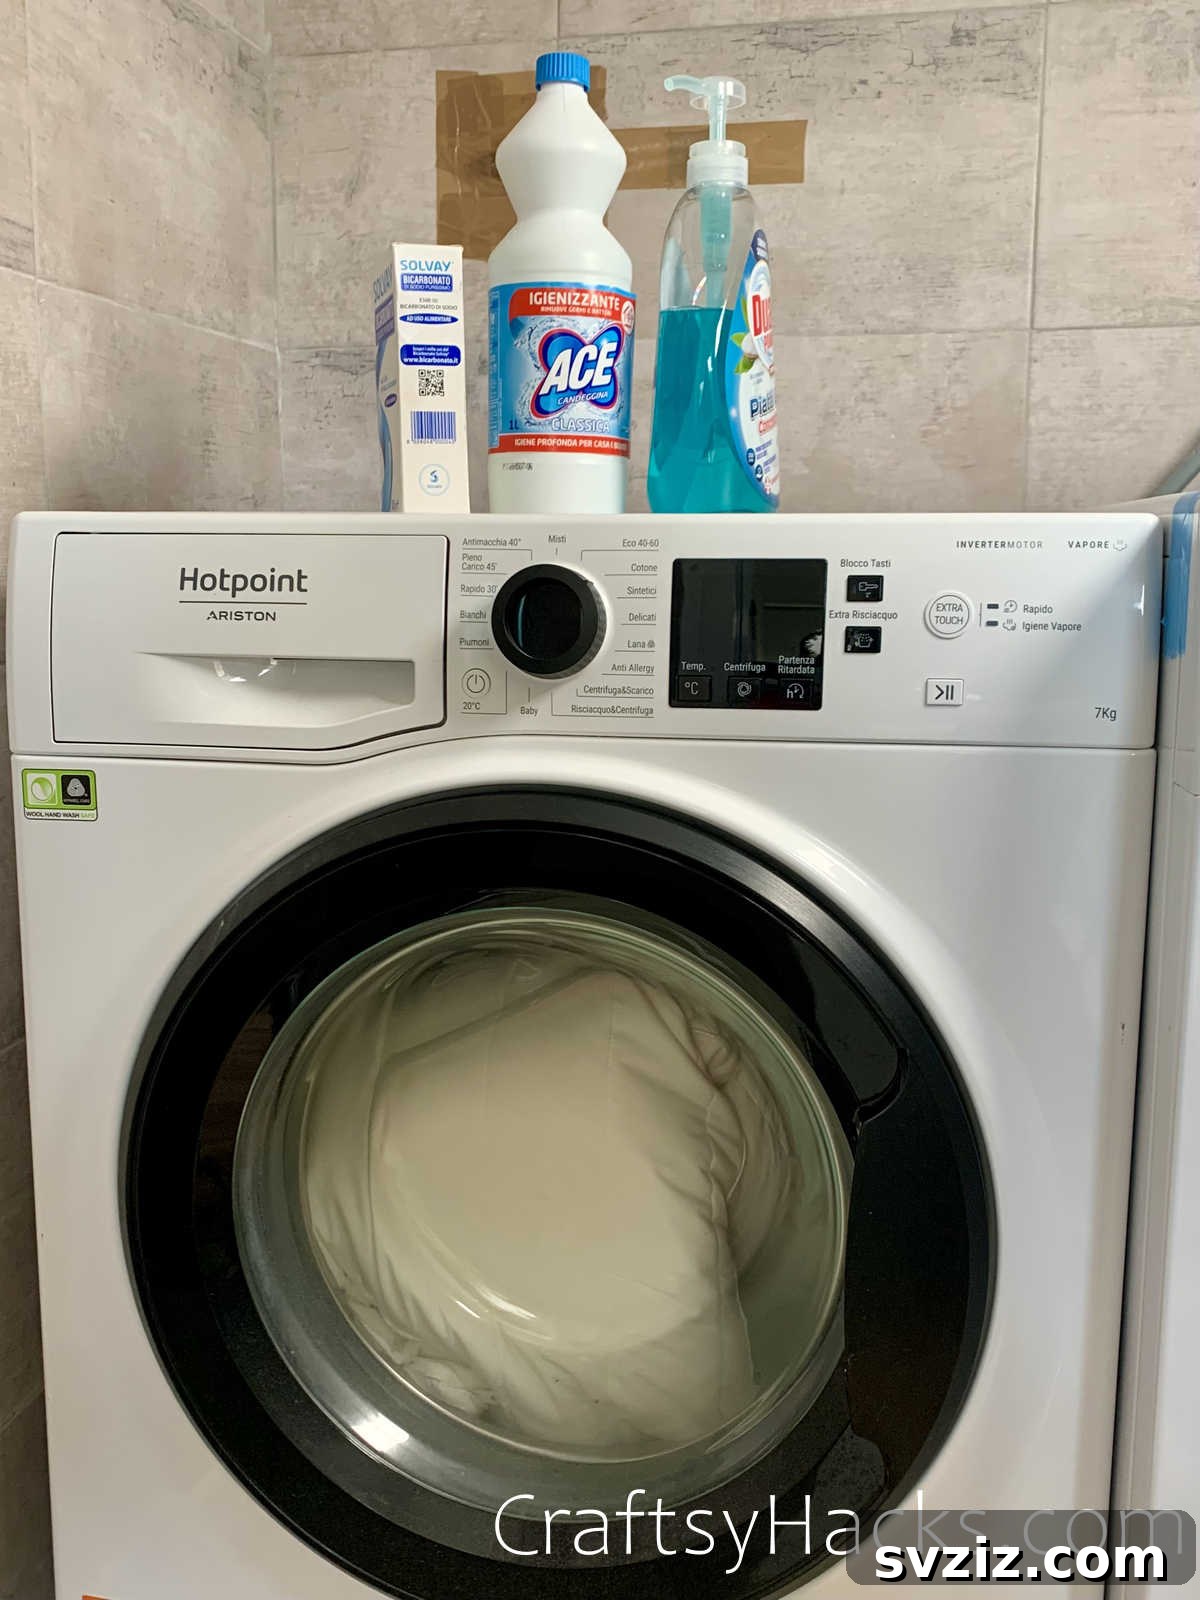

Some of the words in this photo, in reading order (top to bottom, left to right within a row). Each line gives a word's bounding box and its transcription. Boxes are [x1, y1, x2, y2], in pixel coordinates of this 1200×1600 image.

[400, 260, 452, 271] SOLVAY
[403, 275, 451, 285] BICARBONATO
[528, 291, 620, 310] IGIENIZZANTE
[538, 341, 618, 395] ACE
[557, 391, 608, 405] CANDEGGINA
[514, 438, 536, 446] IGIENE
[537, 438, 578, 447] PROFONDA
[579, 439, 593, 448] PER
[462, 537, 507, 546] Antimacchia
[548, 535, 567, 544] Misti
[622, 539, 637, 547] Eco
[638, 539, 660, 547] 40-60
[1067, 540, 1110, 549] VAPORE
[462, 553, 483, 561] Pieno
[461, 562, 485, 570] Carico
[631, 563, 658, 572] Cotone
[840, 559, 869, 568] Blocco
[871, 559, 892, 568] Tasti
[179, 567, 308, 598] Hotpoint
[460, 584, 486, 594] Rapido
[627, 586, 657, 595] Sintetici
[936, 603, 964, 612] EXTRA
[1023, 605, 1054, 615] Rapido
[206, 610, 277, 621] ARISTON
[460, 610, 487, 619] Bianchi
[628, 613, 657, 622] Delicati
[828, 610, 850, 619] Extra
[852, 611, 898, 621] Risciacquo
[934, 616, 964, 625] TOUCH
[1022, 622, 1049, 632] Igiene
[1051, 623, 1082, 633] Vapore
[459, 637, 490, 647] Piumoni
[628, 640, 647, 649] Lana
[778, 656, 815, 666] Partenza
[611, 663, 628, 672] Anti
[628, 664, 655, 674] Allergy
[681, 662, 707, 673] Temp.
[723, 663, 767, 674] Centrifuga
[777, 665, 816, 674] Ritardata
[583, 685, 655, 696] Centrifuga&Scarico
[463, 702, 481, 711] 20°C
[520, 706, 539, 717] Baby
[571, 704, 655, 716] Risciacquo&Centrifuga
[1094, 707, 1118, 722] 7Kg
